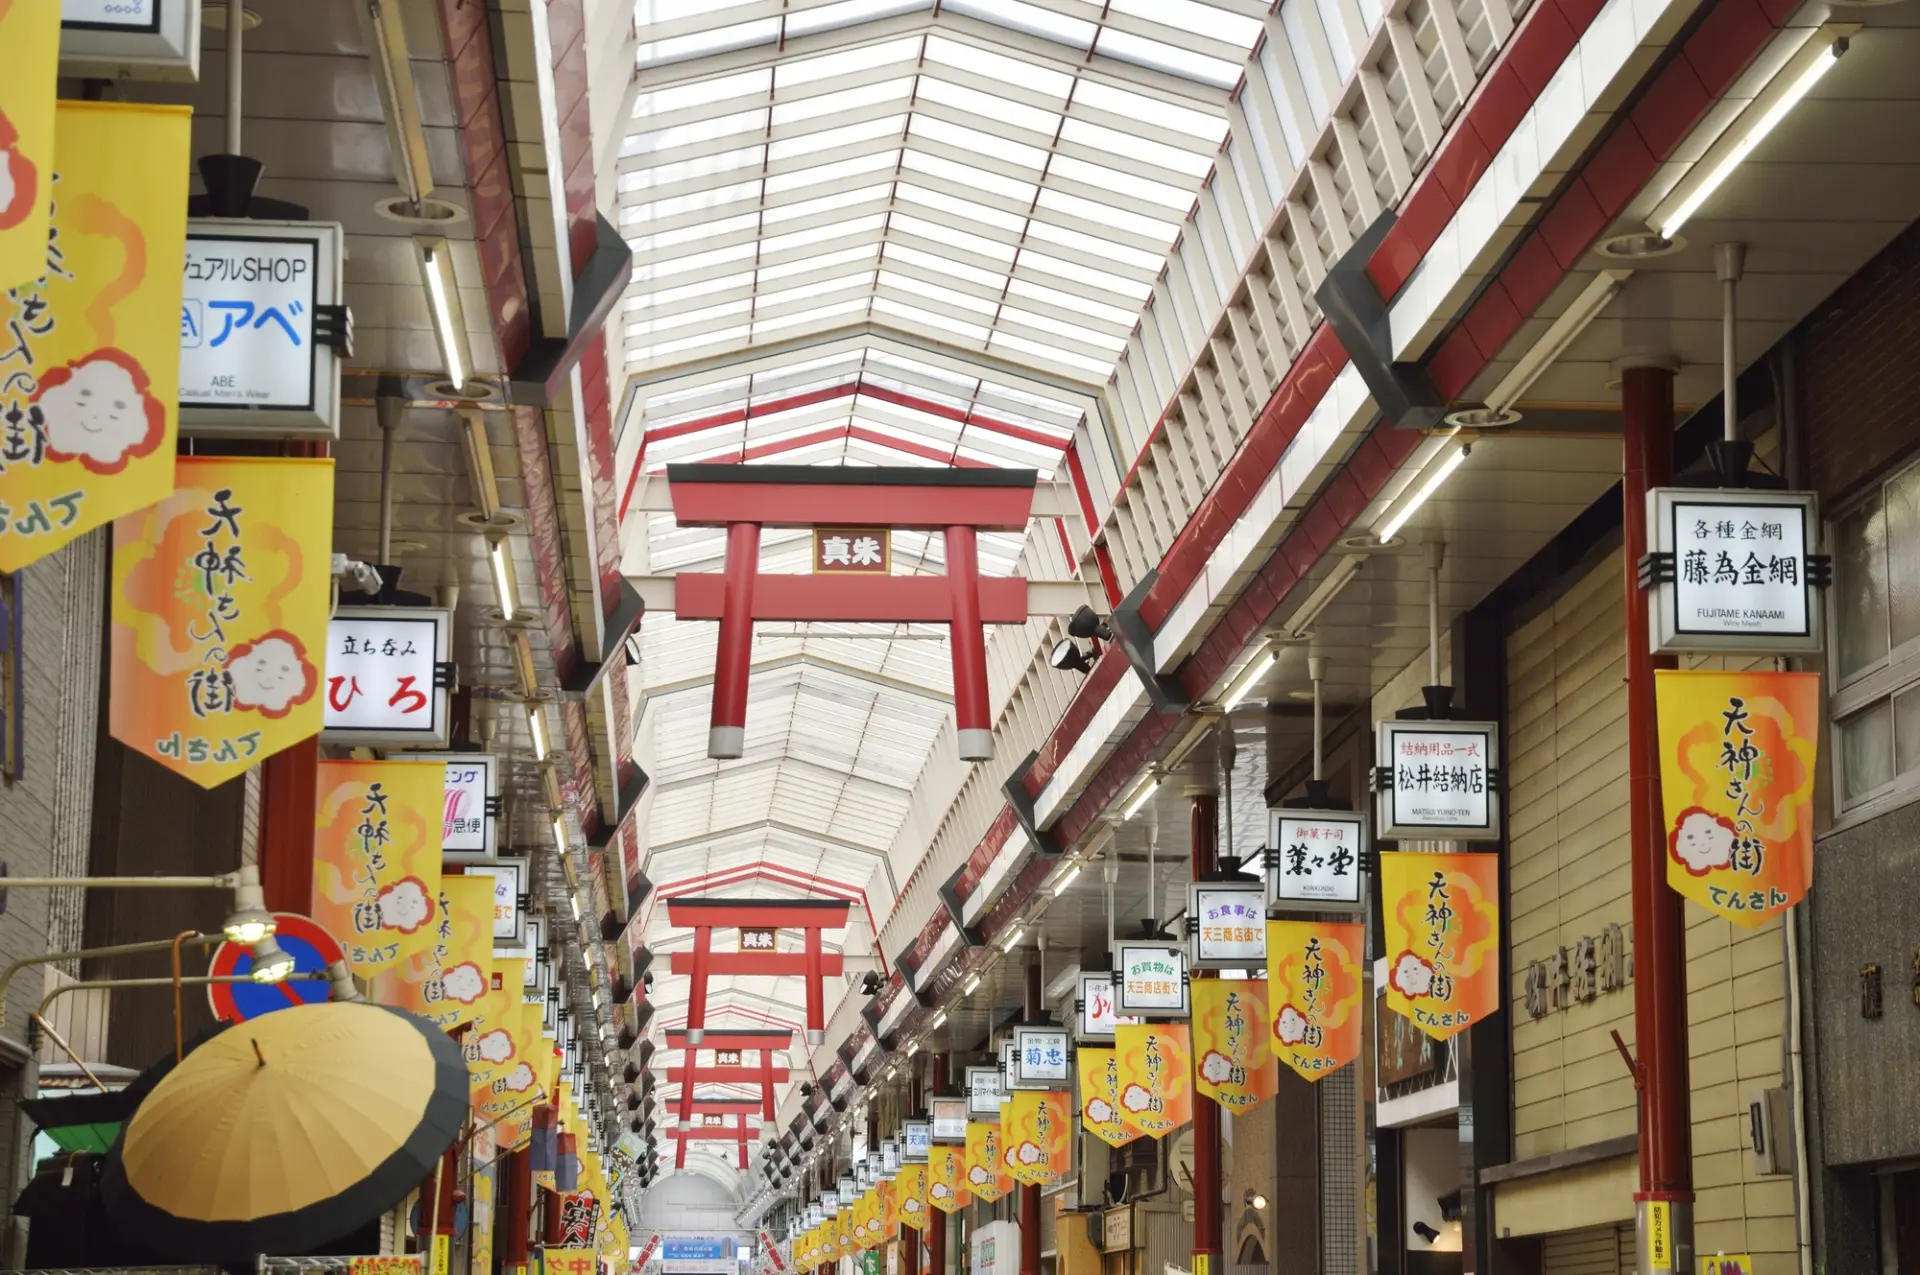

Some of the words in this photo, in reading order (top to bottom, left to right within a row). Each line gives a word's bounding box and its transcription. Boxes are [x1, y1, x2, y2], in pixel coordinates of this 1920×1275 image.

[208, 299, 304, 348] アベ
[210, 375, 236, 387] ABE
[1693, 518, 1783, 541] 各種金網
[821, 535, 882, 566] 真朱
[1682, 548, 1799, 587] 藤為金網
[1697, 607, 1741, 619] FUJITAME
[1743, 609, 1786, 620] KANAAMI
[341, 635, 417, 657] 立ち呑み
[327, 675, 428, 714] ひろ
[1400, 741, 1481, 757] 結納用品一式
[1398, 762, 1484, 794] 松井結納店
[1717, 696, 1767, 878] 天神さんの街
[1411, 808, 1436, 816] MATSUI
[1295, 827, 1344, 841] 御菓子司
[1706, 883, 1789, 912] てんさん
[1207, 903, 1258, 920] お食事は
[743, 931, 774, 949] 真朱
[1202, 926, 1264, 943] 天三商店街で
[1425, 871, 1456, 1002] 天神さんの街
[1130, 961, 1175, 976] お買物は
[1524, 922, 1634, 1022] 松井結納
[1126, 980, 1179, 995] 天三商店街で
[1301, 937, 1327, 1049] 天神さんの街
[1414, 1008, 1469, 1027] てんさん
[717, 1051, 739, 1065] 真朱
[1025, 1047, 1064, 1066] 菊忠
[1292, 1052, 1337, 1070] てんさん
[1219, 1091, 1258, 1106] てんさん
[1140, 1118, 1174, 1129] てんさん
[1101, 1128, 1133, 1140] てんさん
[1030, 1168, 1057, 1178] てんさん
[1653, 1206, 1665, 1260] 防犯カメラ作動中
